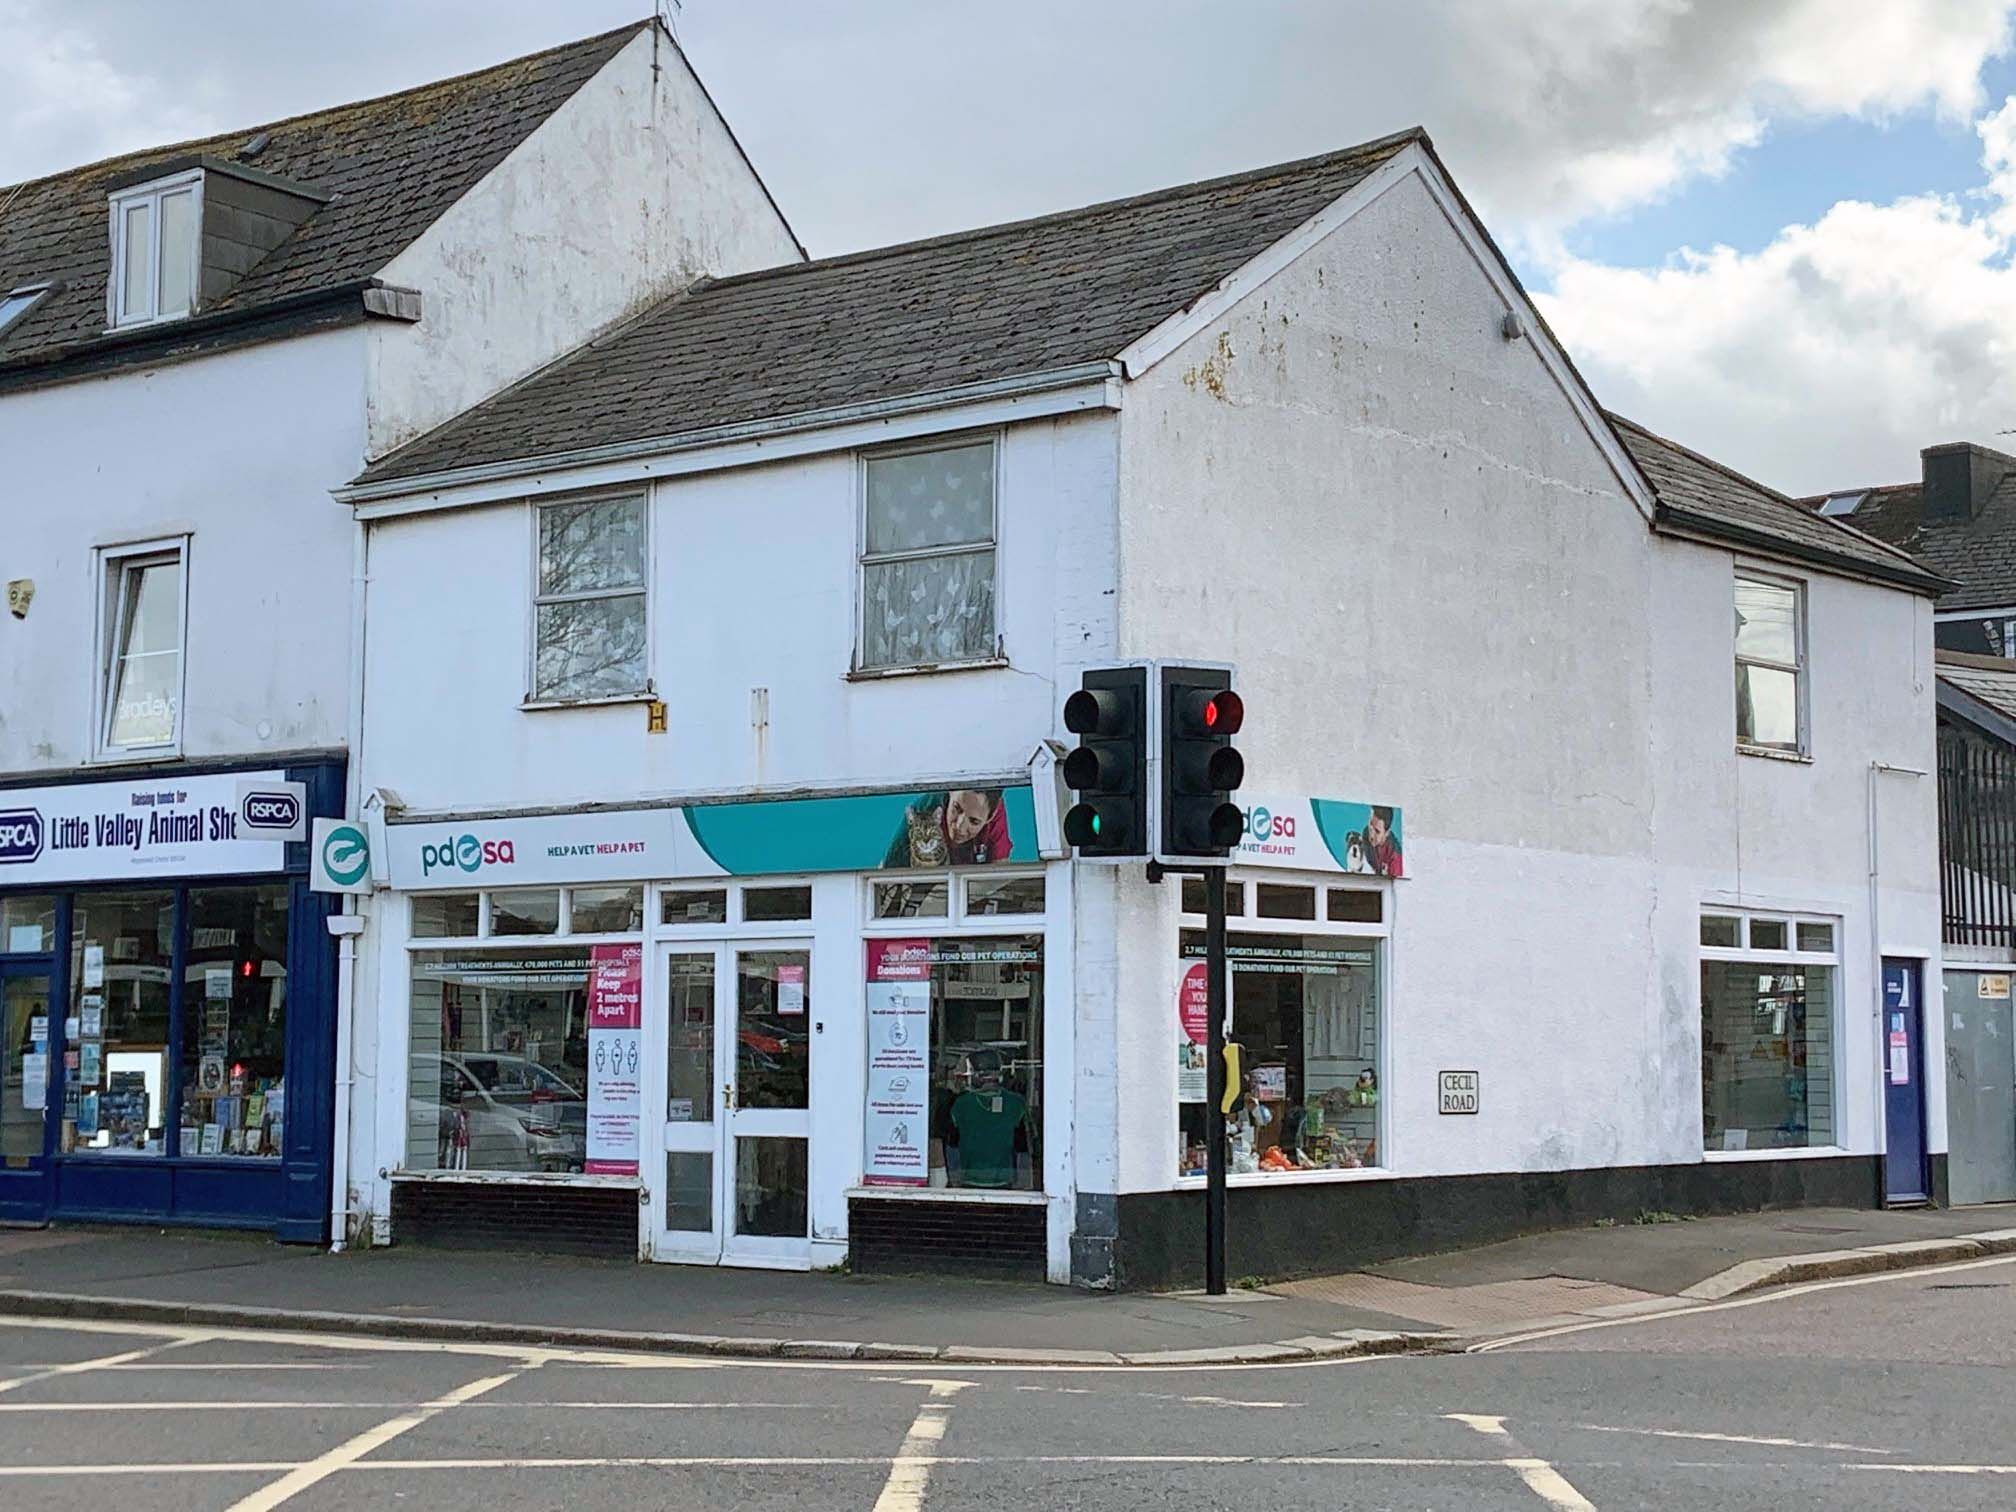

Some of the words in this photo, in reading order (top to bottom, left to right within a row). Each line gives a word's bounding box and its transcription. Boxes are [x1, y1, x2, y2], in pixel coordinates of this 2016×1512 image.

[177, 790, 187, 803] for
[251, 802, 293, 818] RSPCA
[51, 816, 88, 849] Little
[95, 813, 143, 850] Valley
[148, 810, 203, 844] Animal
[209, 806, 237, 842] She
[1241, 806, 1296, 838] dsa
[0, 824, 36, 848] SPCA
[422, 834, 515, 876] pdsa
[547, 846, 569, 856] HELP
[570, 846, 578, 855] A
[578, 845, 595, 855] VET
[597, 843, 619, 854] HELP
[620, 843, 629, 853] A
[628, 842, 645, 852] PET
[941, 952, 960, 961] FUND
[977, 951, 991, 960] PET
[992, 950, 1038, 960] OPERATIONS
[877, 964, 921, 976] Donations
[596, 978, 621, 993] Keep
[1187, 978, 1205, 990] TIME
[596, 991, 604, 1003] 2
[604, 992, 639, 1004] metres
[1192, 991, 1208, 1003] YOU
[597, 1004, 625, 1019] Apart
[1444, 1075, 1474, 1090] CECIL
[1444, 1095, 1475, 1110] ROAD
